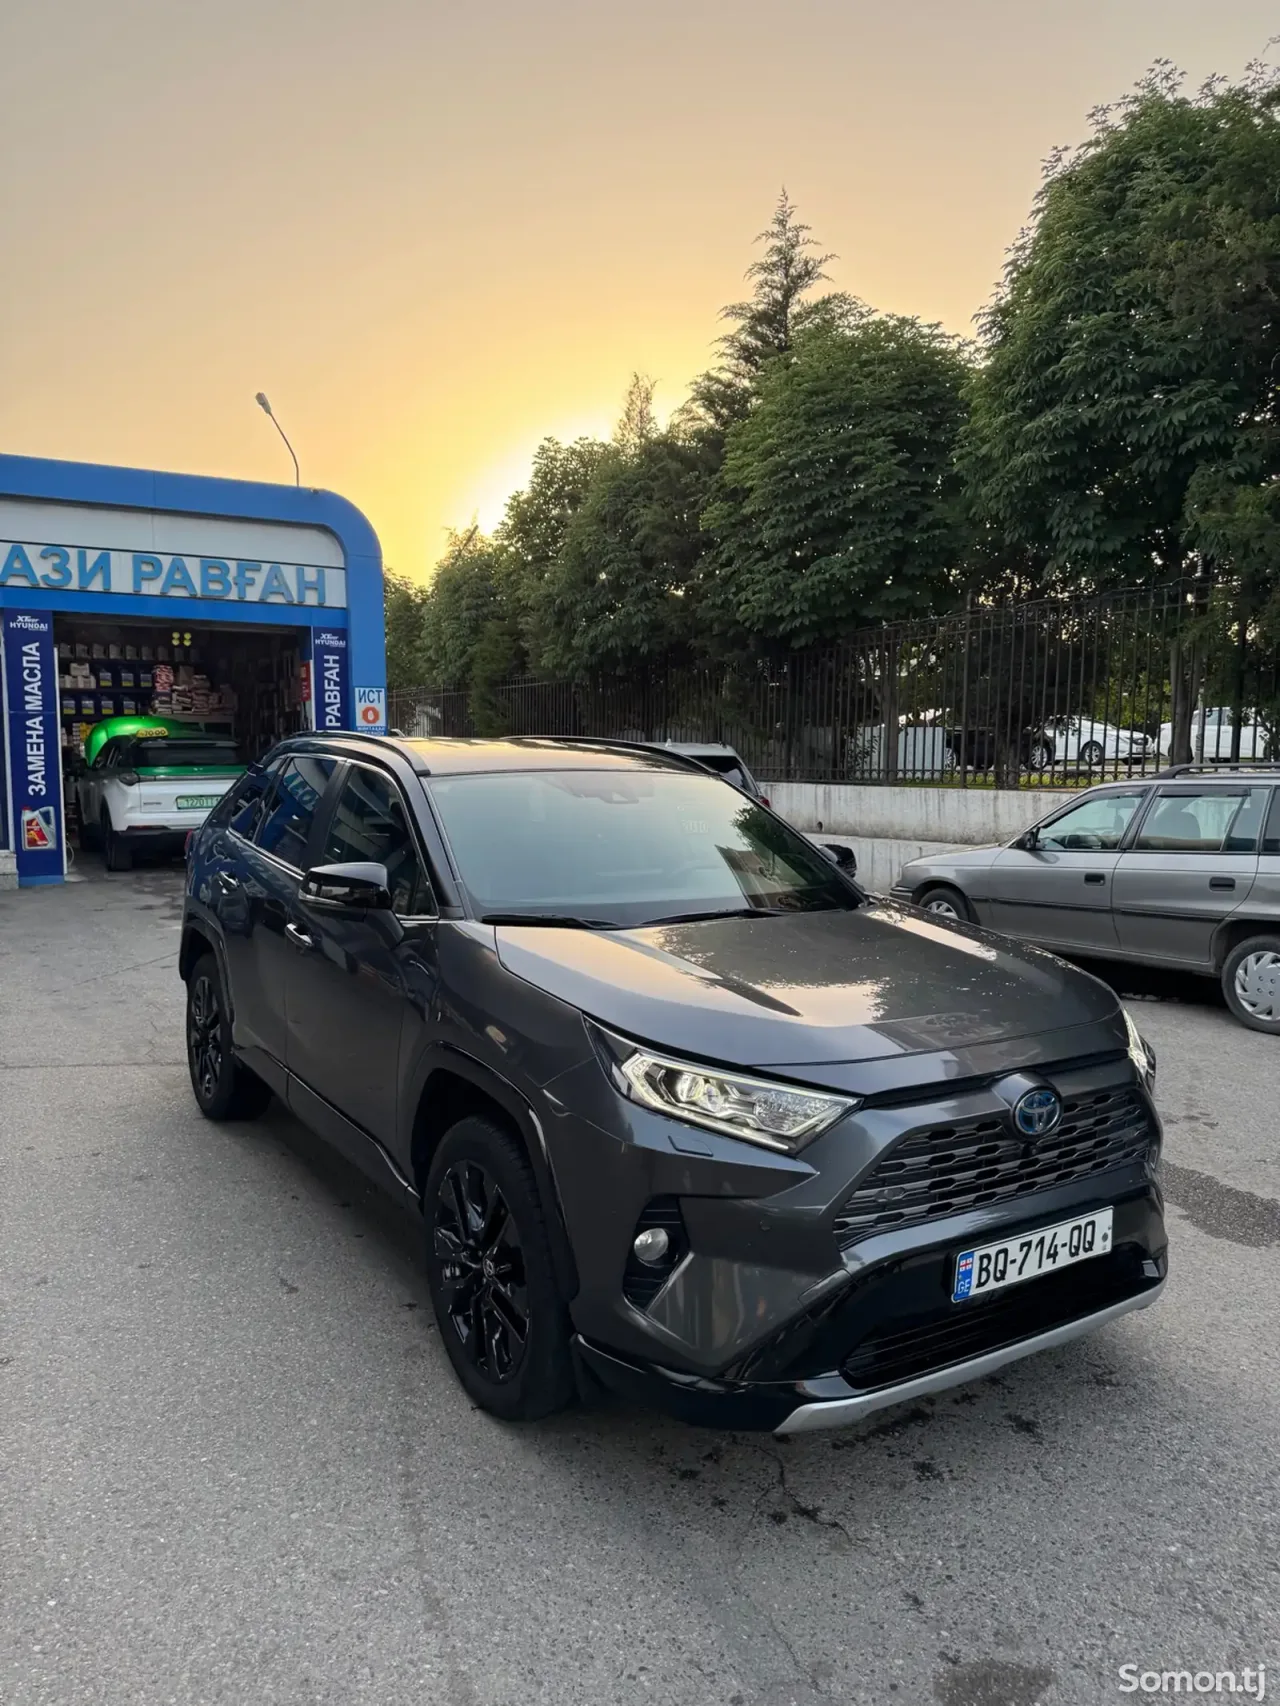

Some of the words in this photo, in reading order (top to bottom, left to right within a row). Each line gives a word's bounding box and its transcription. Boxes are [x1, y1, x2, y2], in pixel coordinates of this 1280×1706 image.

[0, 544, 111, 591] АЗИ
[10, 621, 48, 629] HYUNDAI
[22, 642, 43, 711] МАСЛА
[358, 689, 383, 704] ИСТ
[26, 716, 47, 796] ЗАМЕНА
[975, 1219, 1096, 1289] BQ-714-QQ
[957, 1278, 971, 1294] GE
